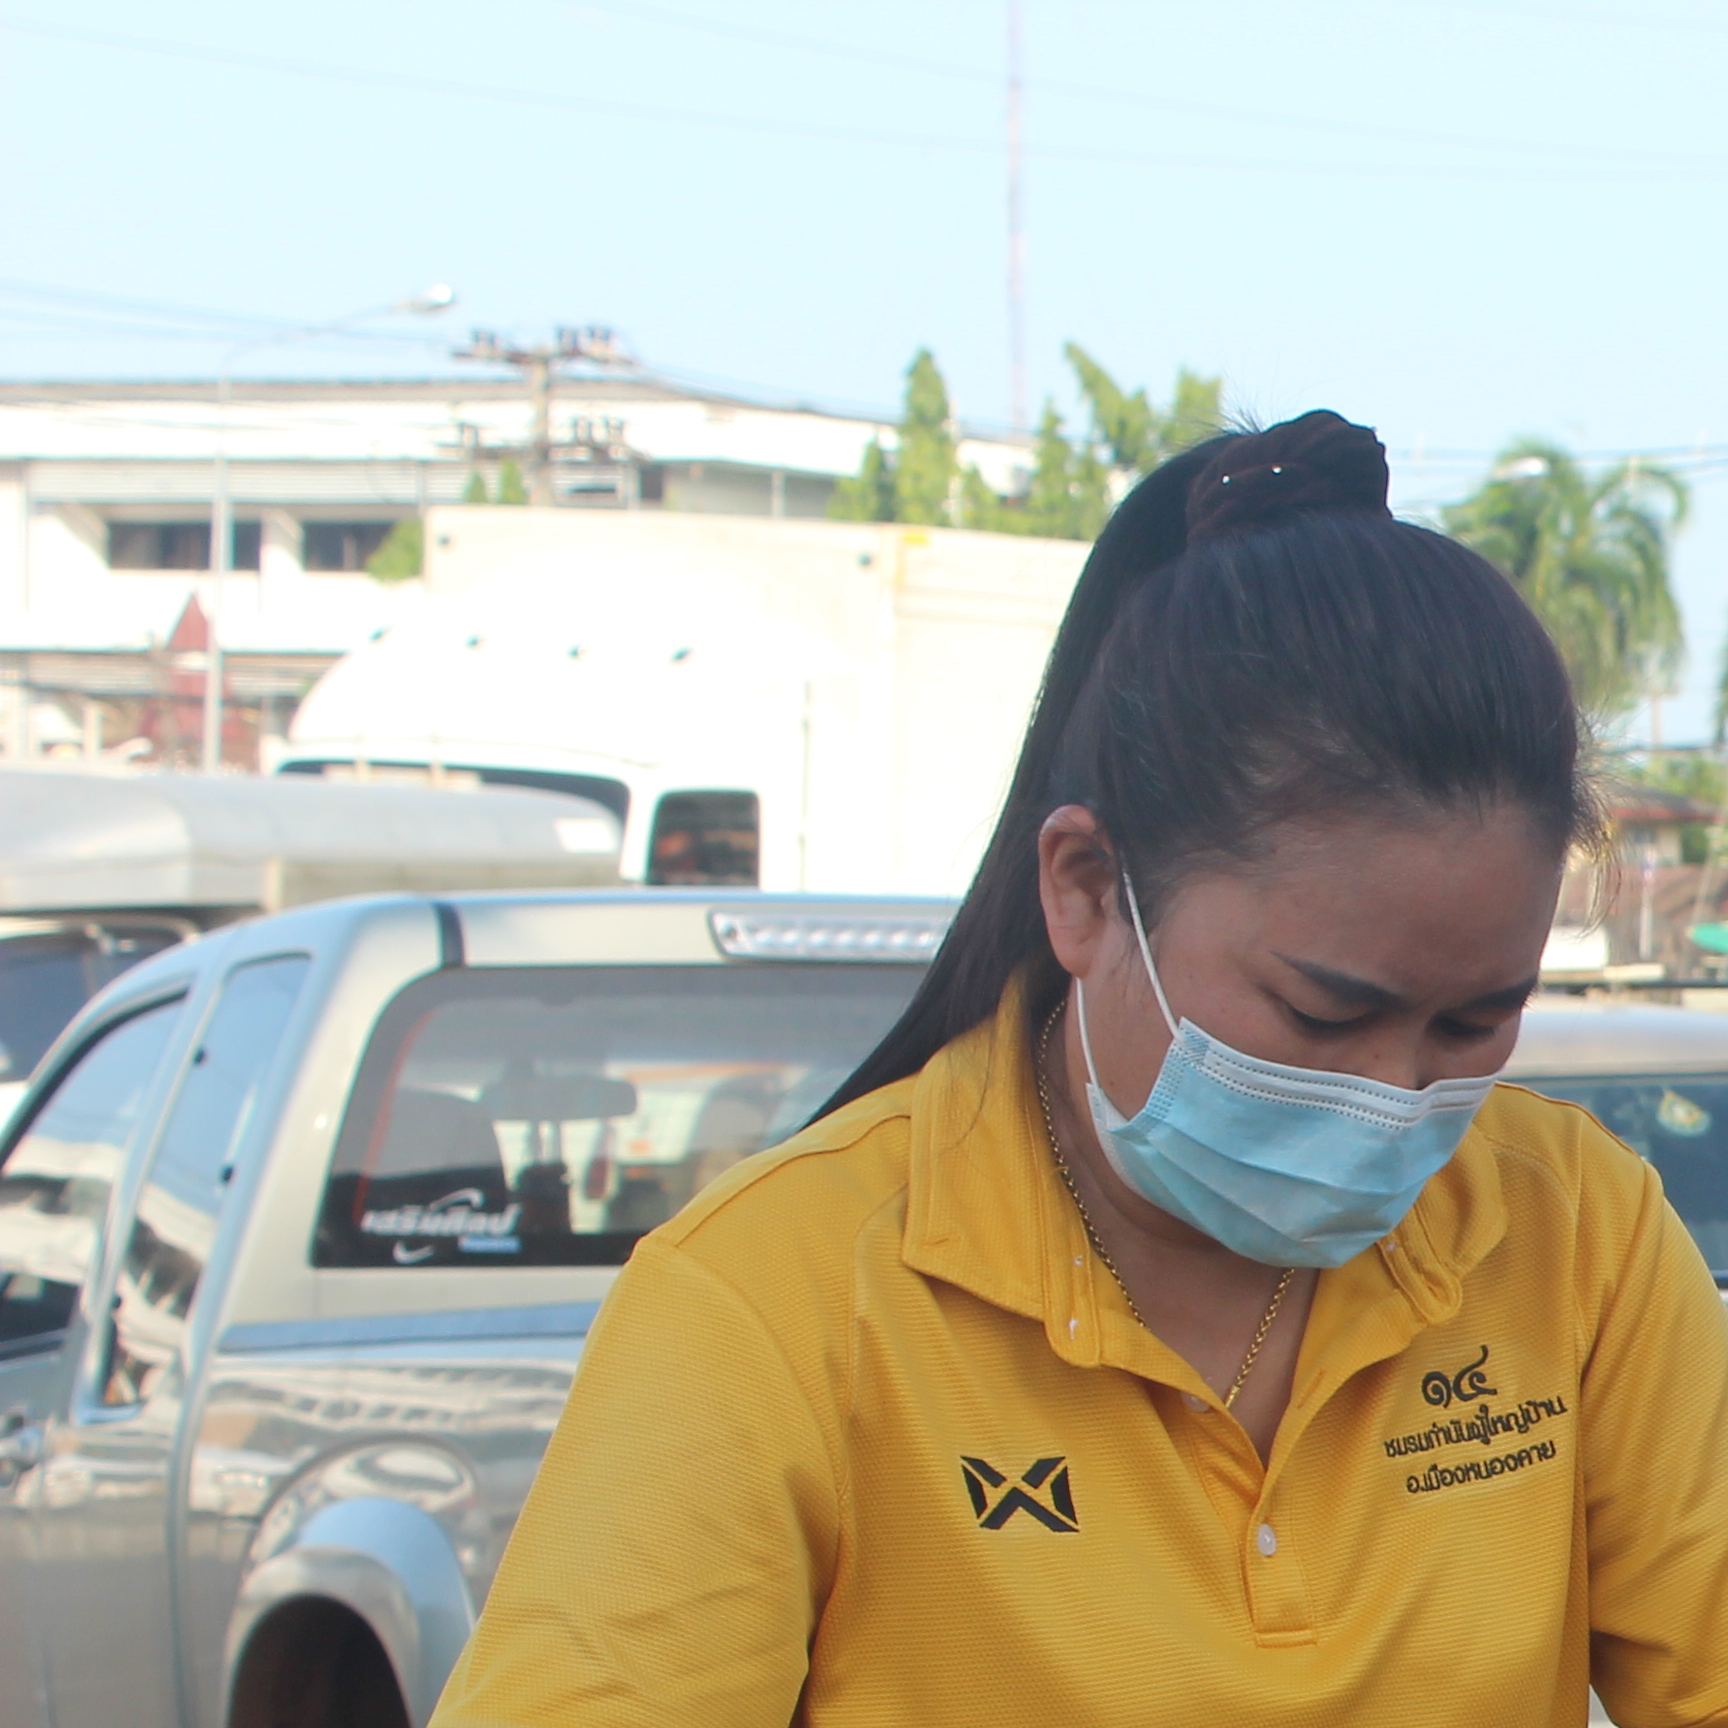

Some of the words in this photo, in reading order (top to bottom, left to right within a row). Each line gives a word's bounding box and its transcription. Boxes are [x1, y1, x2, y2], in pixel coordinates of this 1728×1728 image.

[1421, 1345, 1497, 1408] ๑๔
[1384, 1395, 1568, 1458] ชมรมกำนันผู้ใหญ่บ้าน
[1406, 1440, 1557, 1493] อ.เมืองหนองคาย
